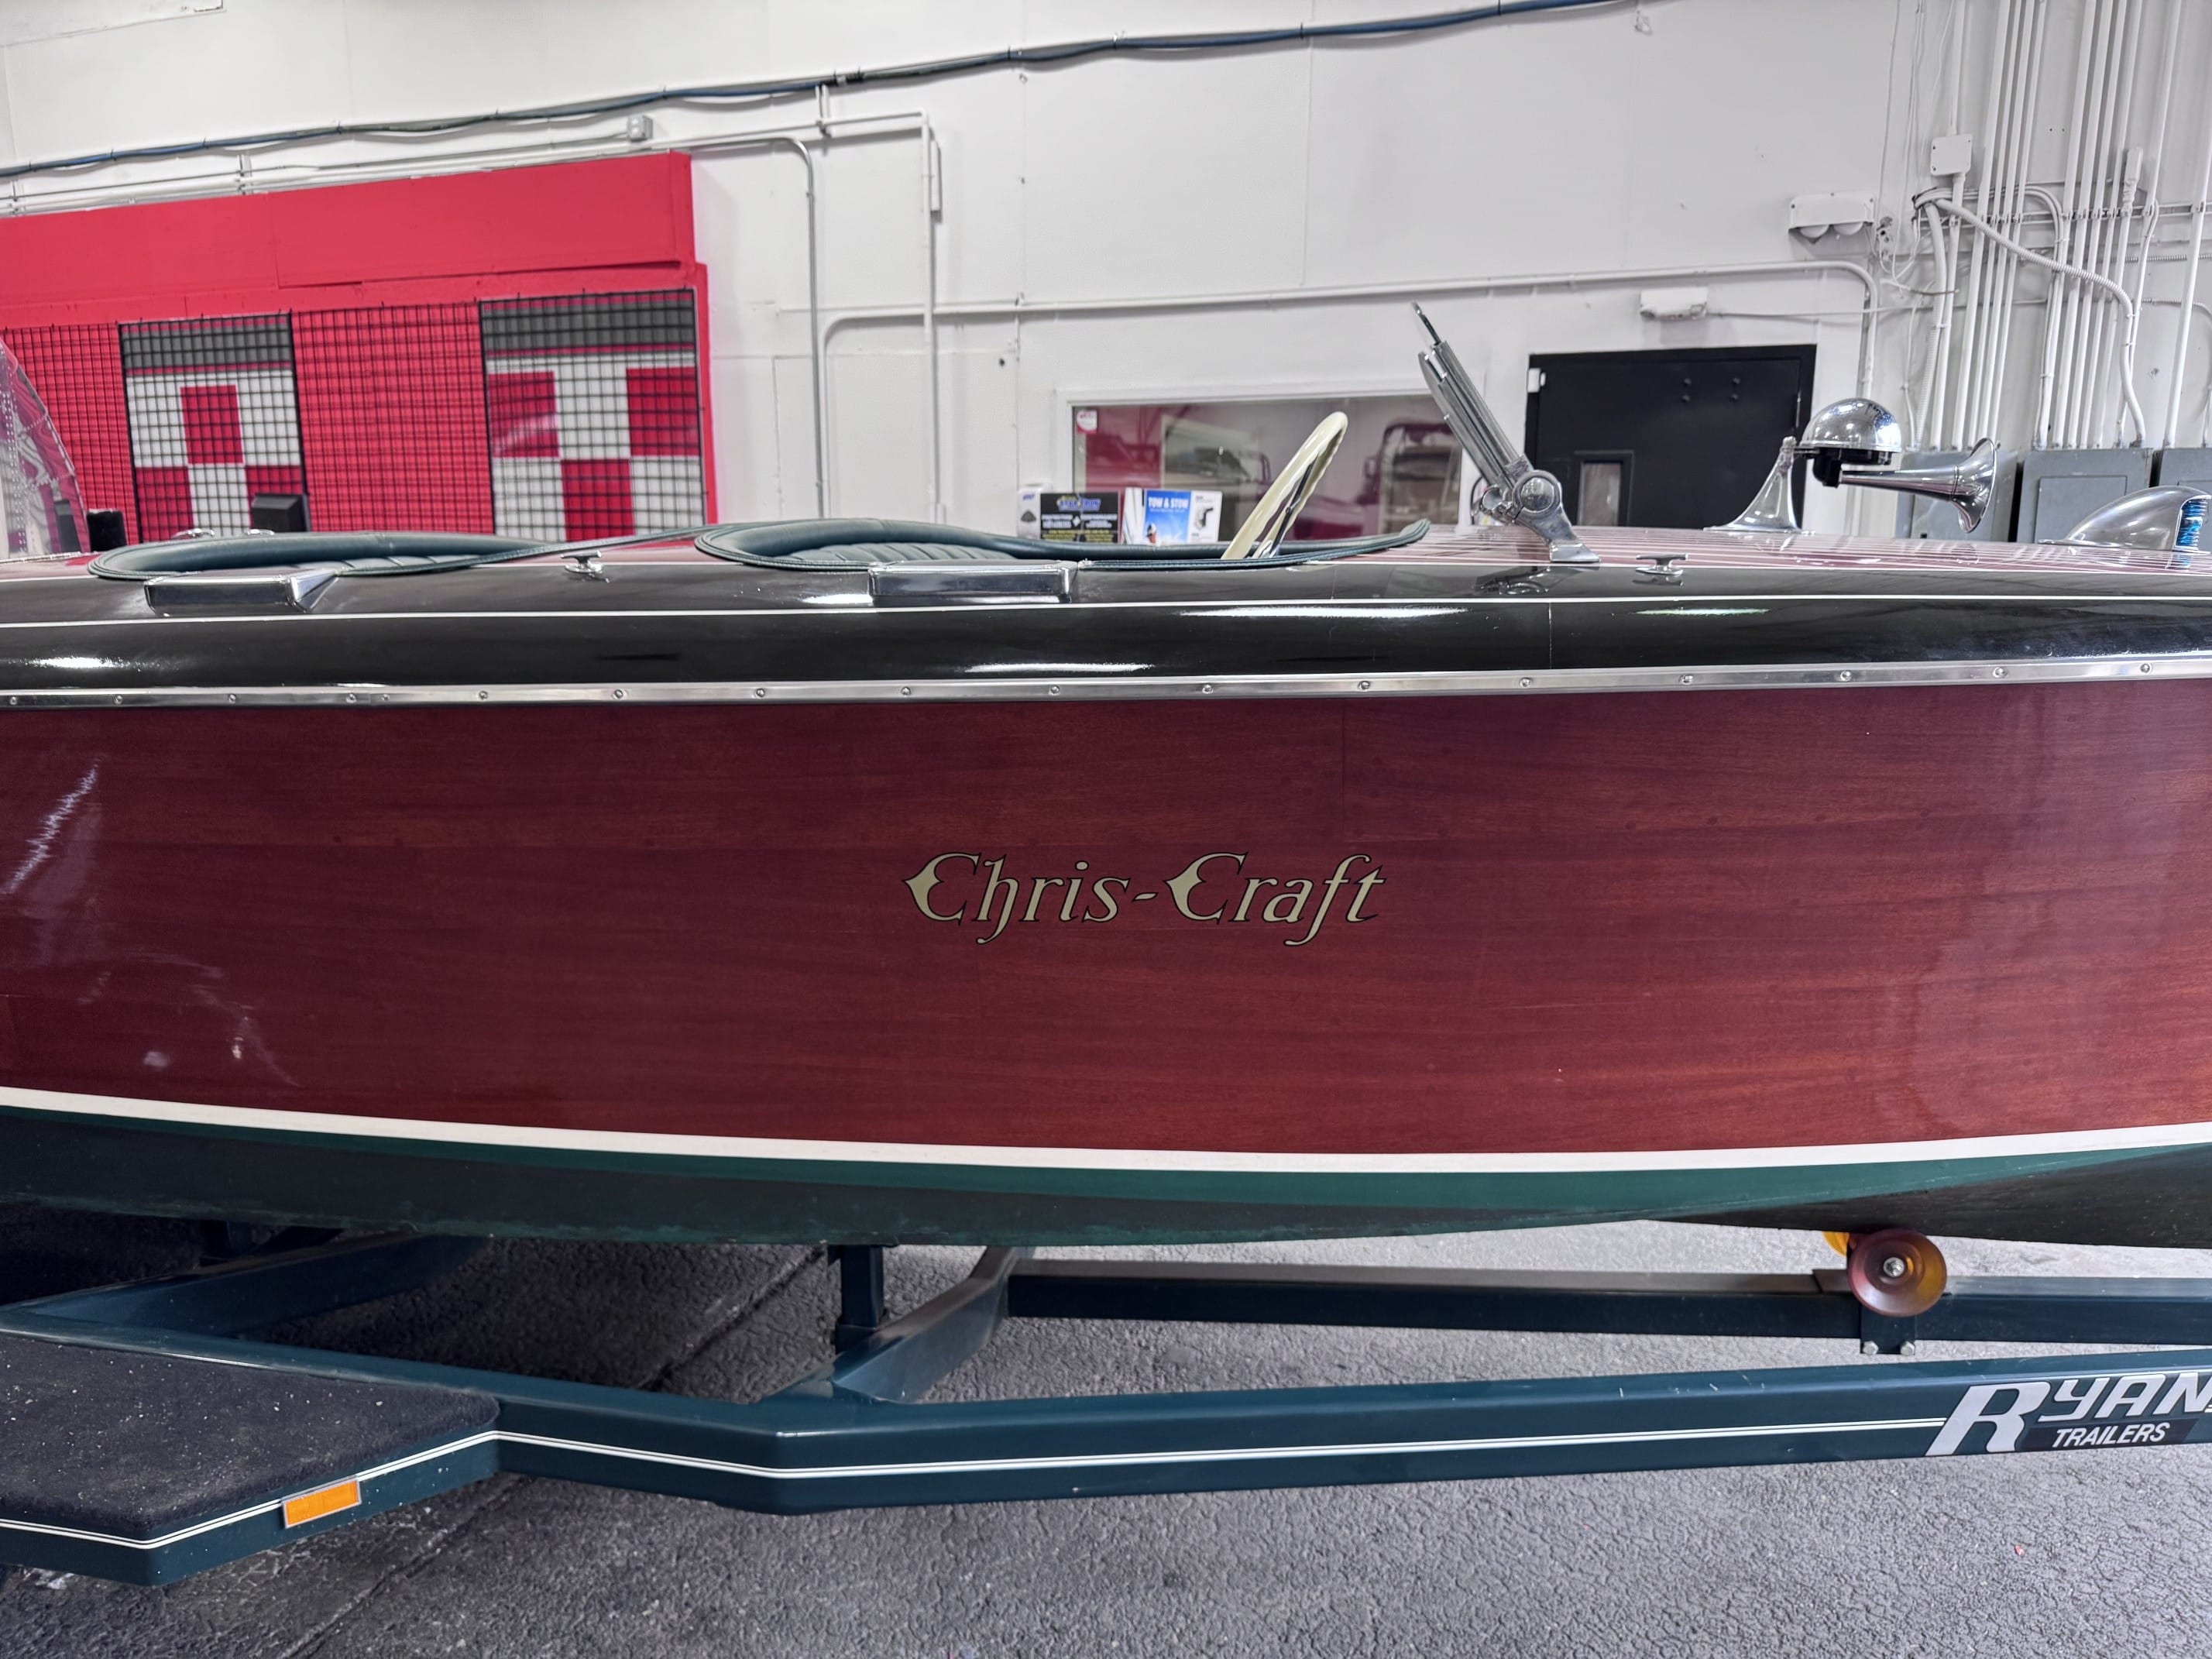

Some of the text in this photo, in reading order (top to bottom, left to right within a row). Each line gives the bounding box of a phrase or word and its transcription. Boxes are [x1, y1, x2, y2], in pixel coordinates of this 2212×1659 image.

[1148, 496, 1163, 509] TOW
[902, 851, 1387, 947] Chris-Craft
[1924, 1371, 2212, 1457] RYAN
[2052, 1422, 2171, 1448] TRAILERS
